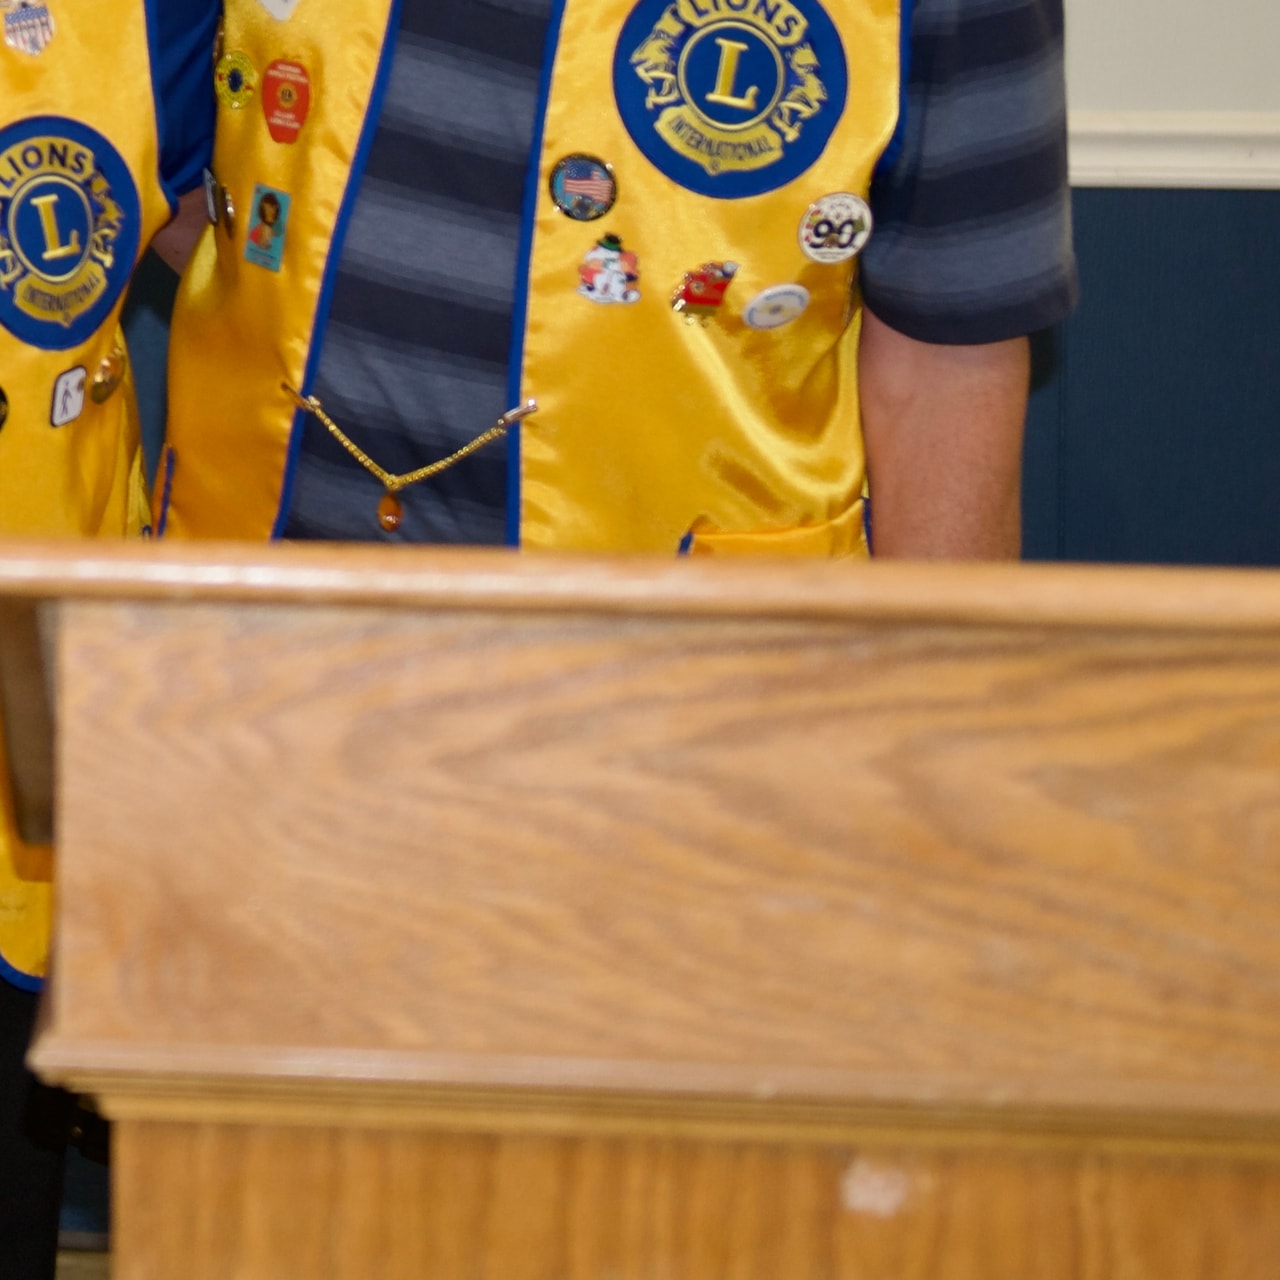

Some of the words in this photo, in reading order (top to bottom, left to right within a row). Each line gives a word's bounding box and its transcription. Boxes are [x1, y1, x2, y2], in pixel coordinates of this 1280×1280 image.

[705, 36, 761, 110] L
[667, 114, 773, 161] INTERNATIONAL
[31, 194, 81, 261] L
[812, 219, 855, 249] 90
[22, 273, 100, 312] INTERNATIONAL
